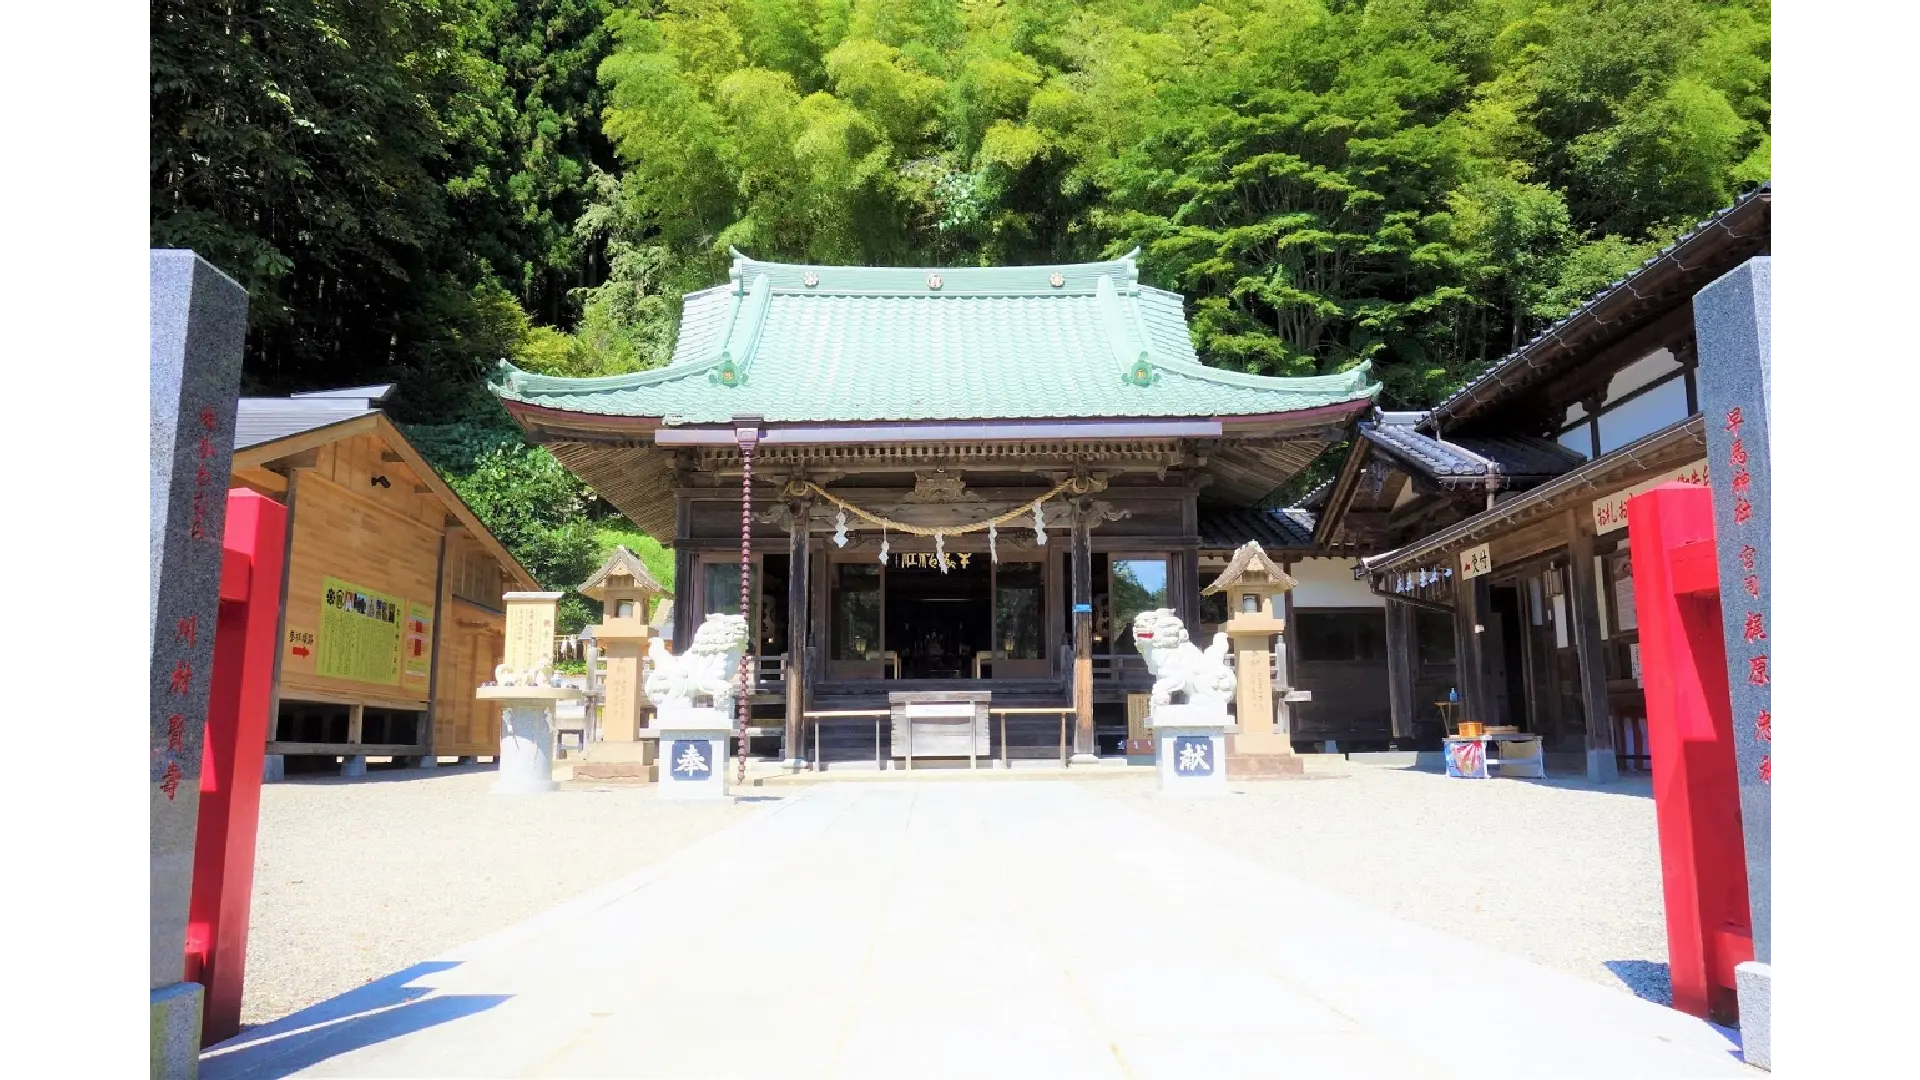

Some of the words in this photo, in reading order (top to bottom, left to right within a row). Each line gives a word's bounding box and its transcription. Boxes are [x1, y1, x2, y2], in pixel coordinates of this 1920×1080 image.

[1472, 549, 1488, 573] 受付
[674, 744, 709, 777] 奉
[1179, 743, 1211, 772] 献
